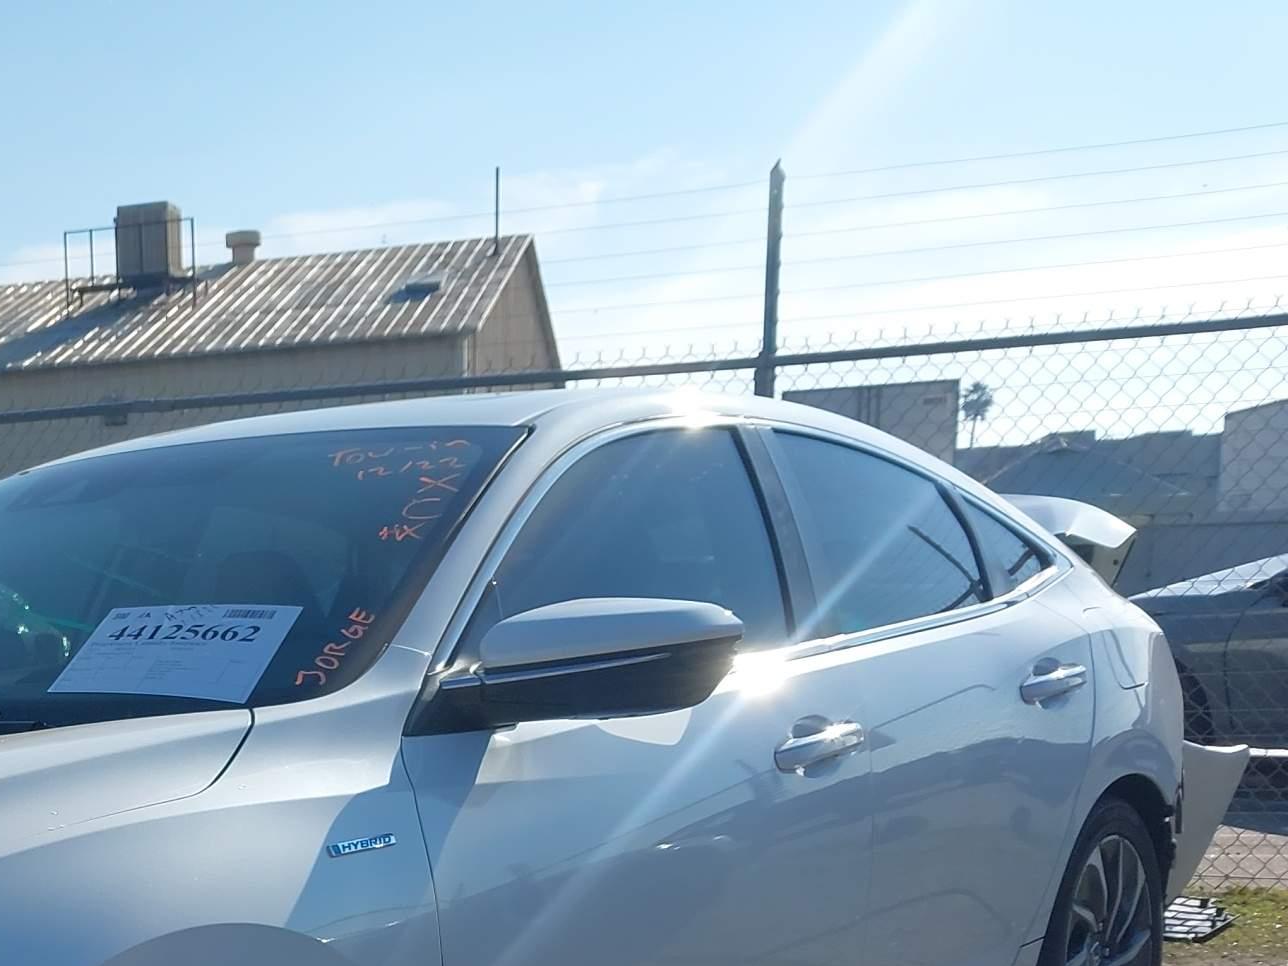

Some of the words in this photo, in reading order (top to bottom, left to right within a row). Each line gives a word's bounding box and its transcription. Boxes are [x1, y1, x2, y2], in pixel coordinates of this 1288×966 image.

[108, 624, 261, 642] 44125662
[295, 607, 375, 685] JORGE
[343, 836, 391, 851] HYBRID
